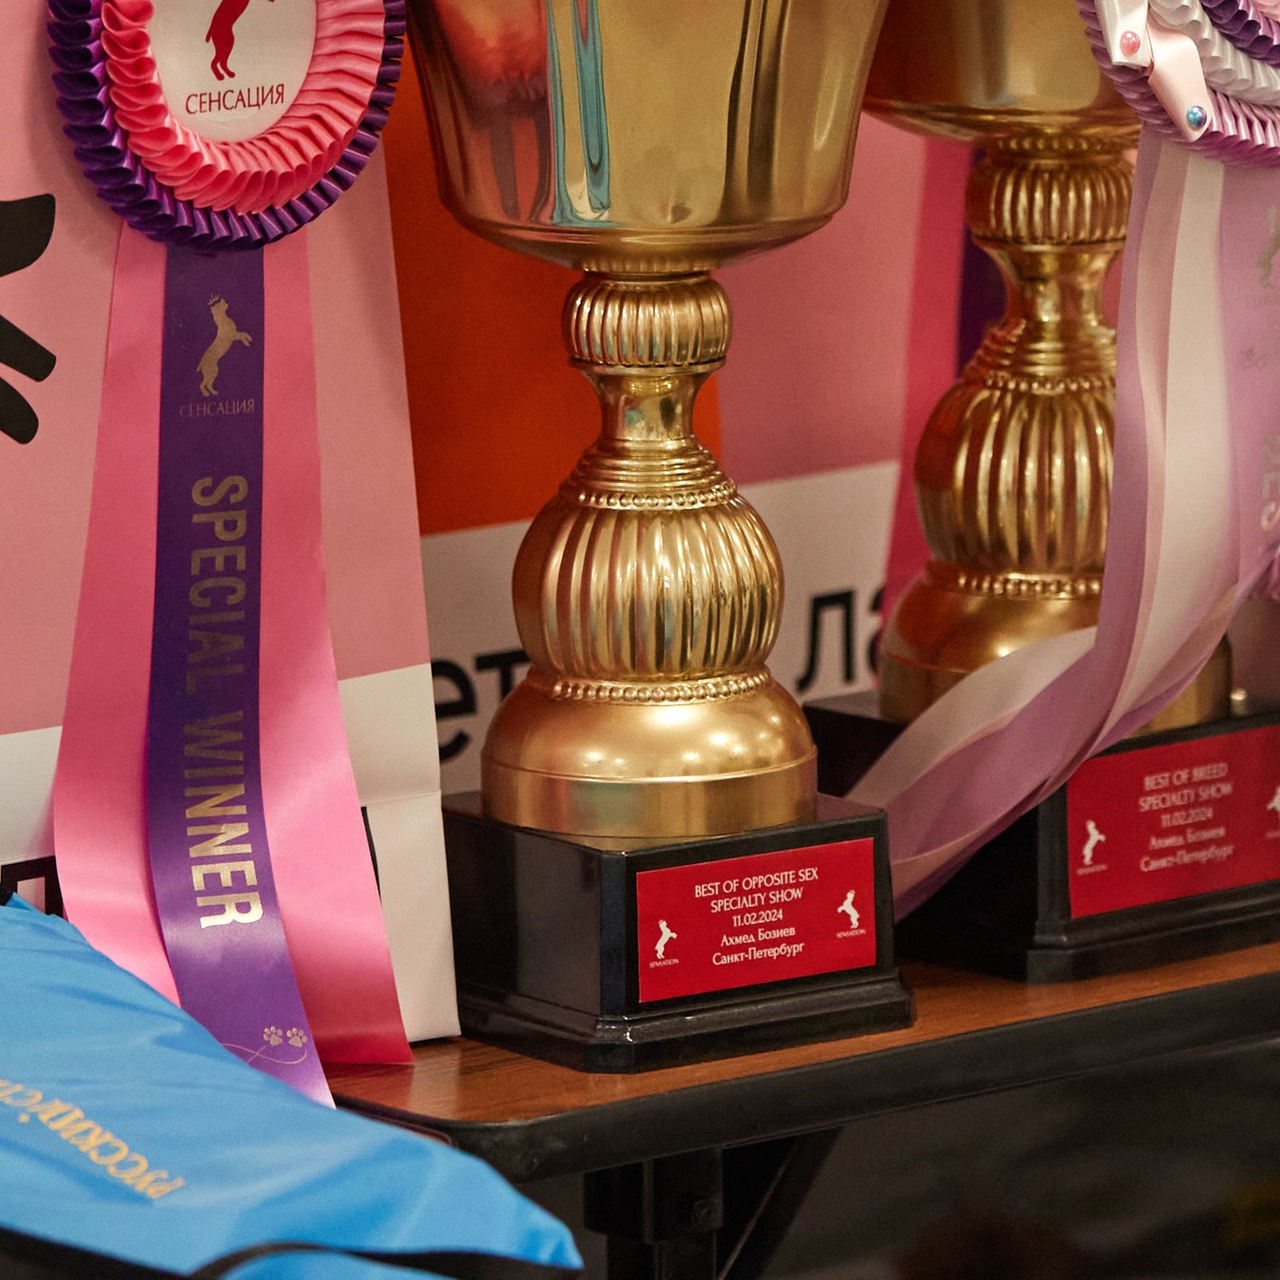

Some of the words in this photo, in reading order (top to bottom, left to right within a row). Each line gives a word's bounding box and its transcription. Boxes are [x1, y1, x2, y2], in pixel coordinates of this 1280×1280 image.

[185, 83, 285, 115] СЕНСАЦИЯ
[185, 475, 249, 697] SPECIAL
[1144, 773, 1170, 791] BEST
[1172, 769, 1189, 786] OF
[1138, 789, 1196, 812] SPECIALTY
[1198, 781, 1234, 801] SHOW
[184, 709, 264, 929] WINNER
[695, 882, 720, 898] BEST
[722, 878, 739, 894] OF
[742, 871, 796, 891] OPPOSITE
[798, 867, 819, 882] SEX
[711, 893, 767, 913] SPECIALTY
[769, 887, 803, 904] SHOW
[732, 908, 783, 927] 11.02.2024
[720, 932, 755, 947] Ахмед
[758, 926, 796, 941] Бозиев
[712, 942, 805, 966] Санкт-Петербург
